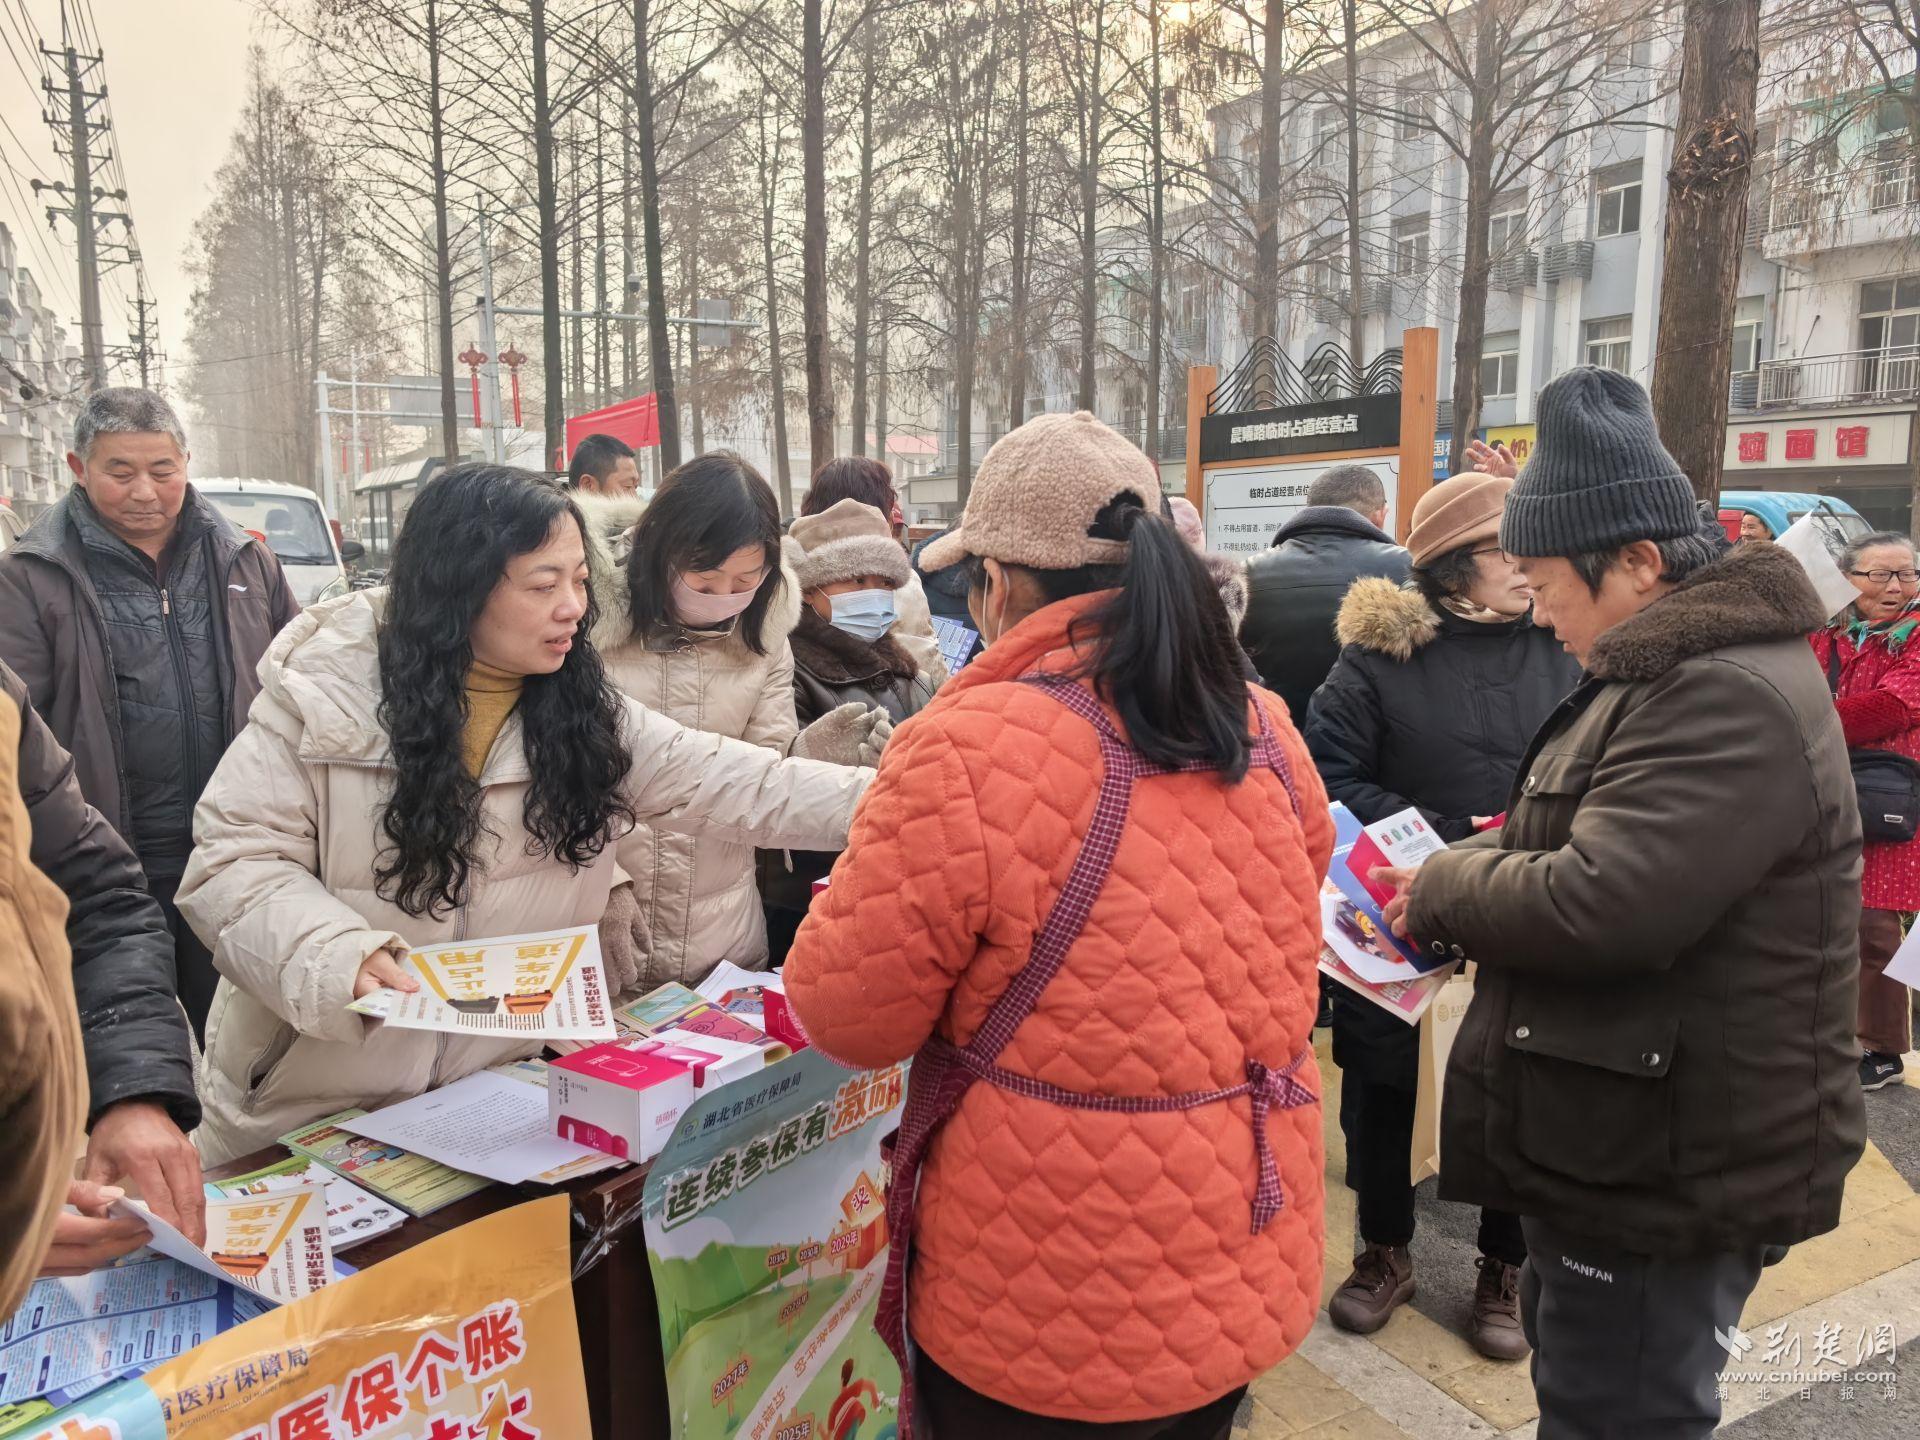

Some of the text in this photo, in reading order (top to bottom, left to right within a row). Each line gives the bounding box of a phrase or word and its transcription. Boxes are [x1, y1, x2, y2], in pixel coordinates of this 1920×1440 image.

[830, 1229, 858, 1254] 2029年
[1562, 1256, 1613, 1283] DIANFAN
[714, 1359, 749, 1399] 2027年
[775, 1421, 811, 1440] 2025年
